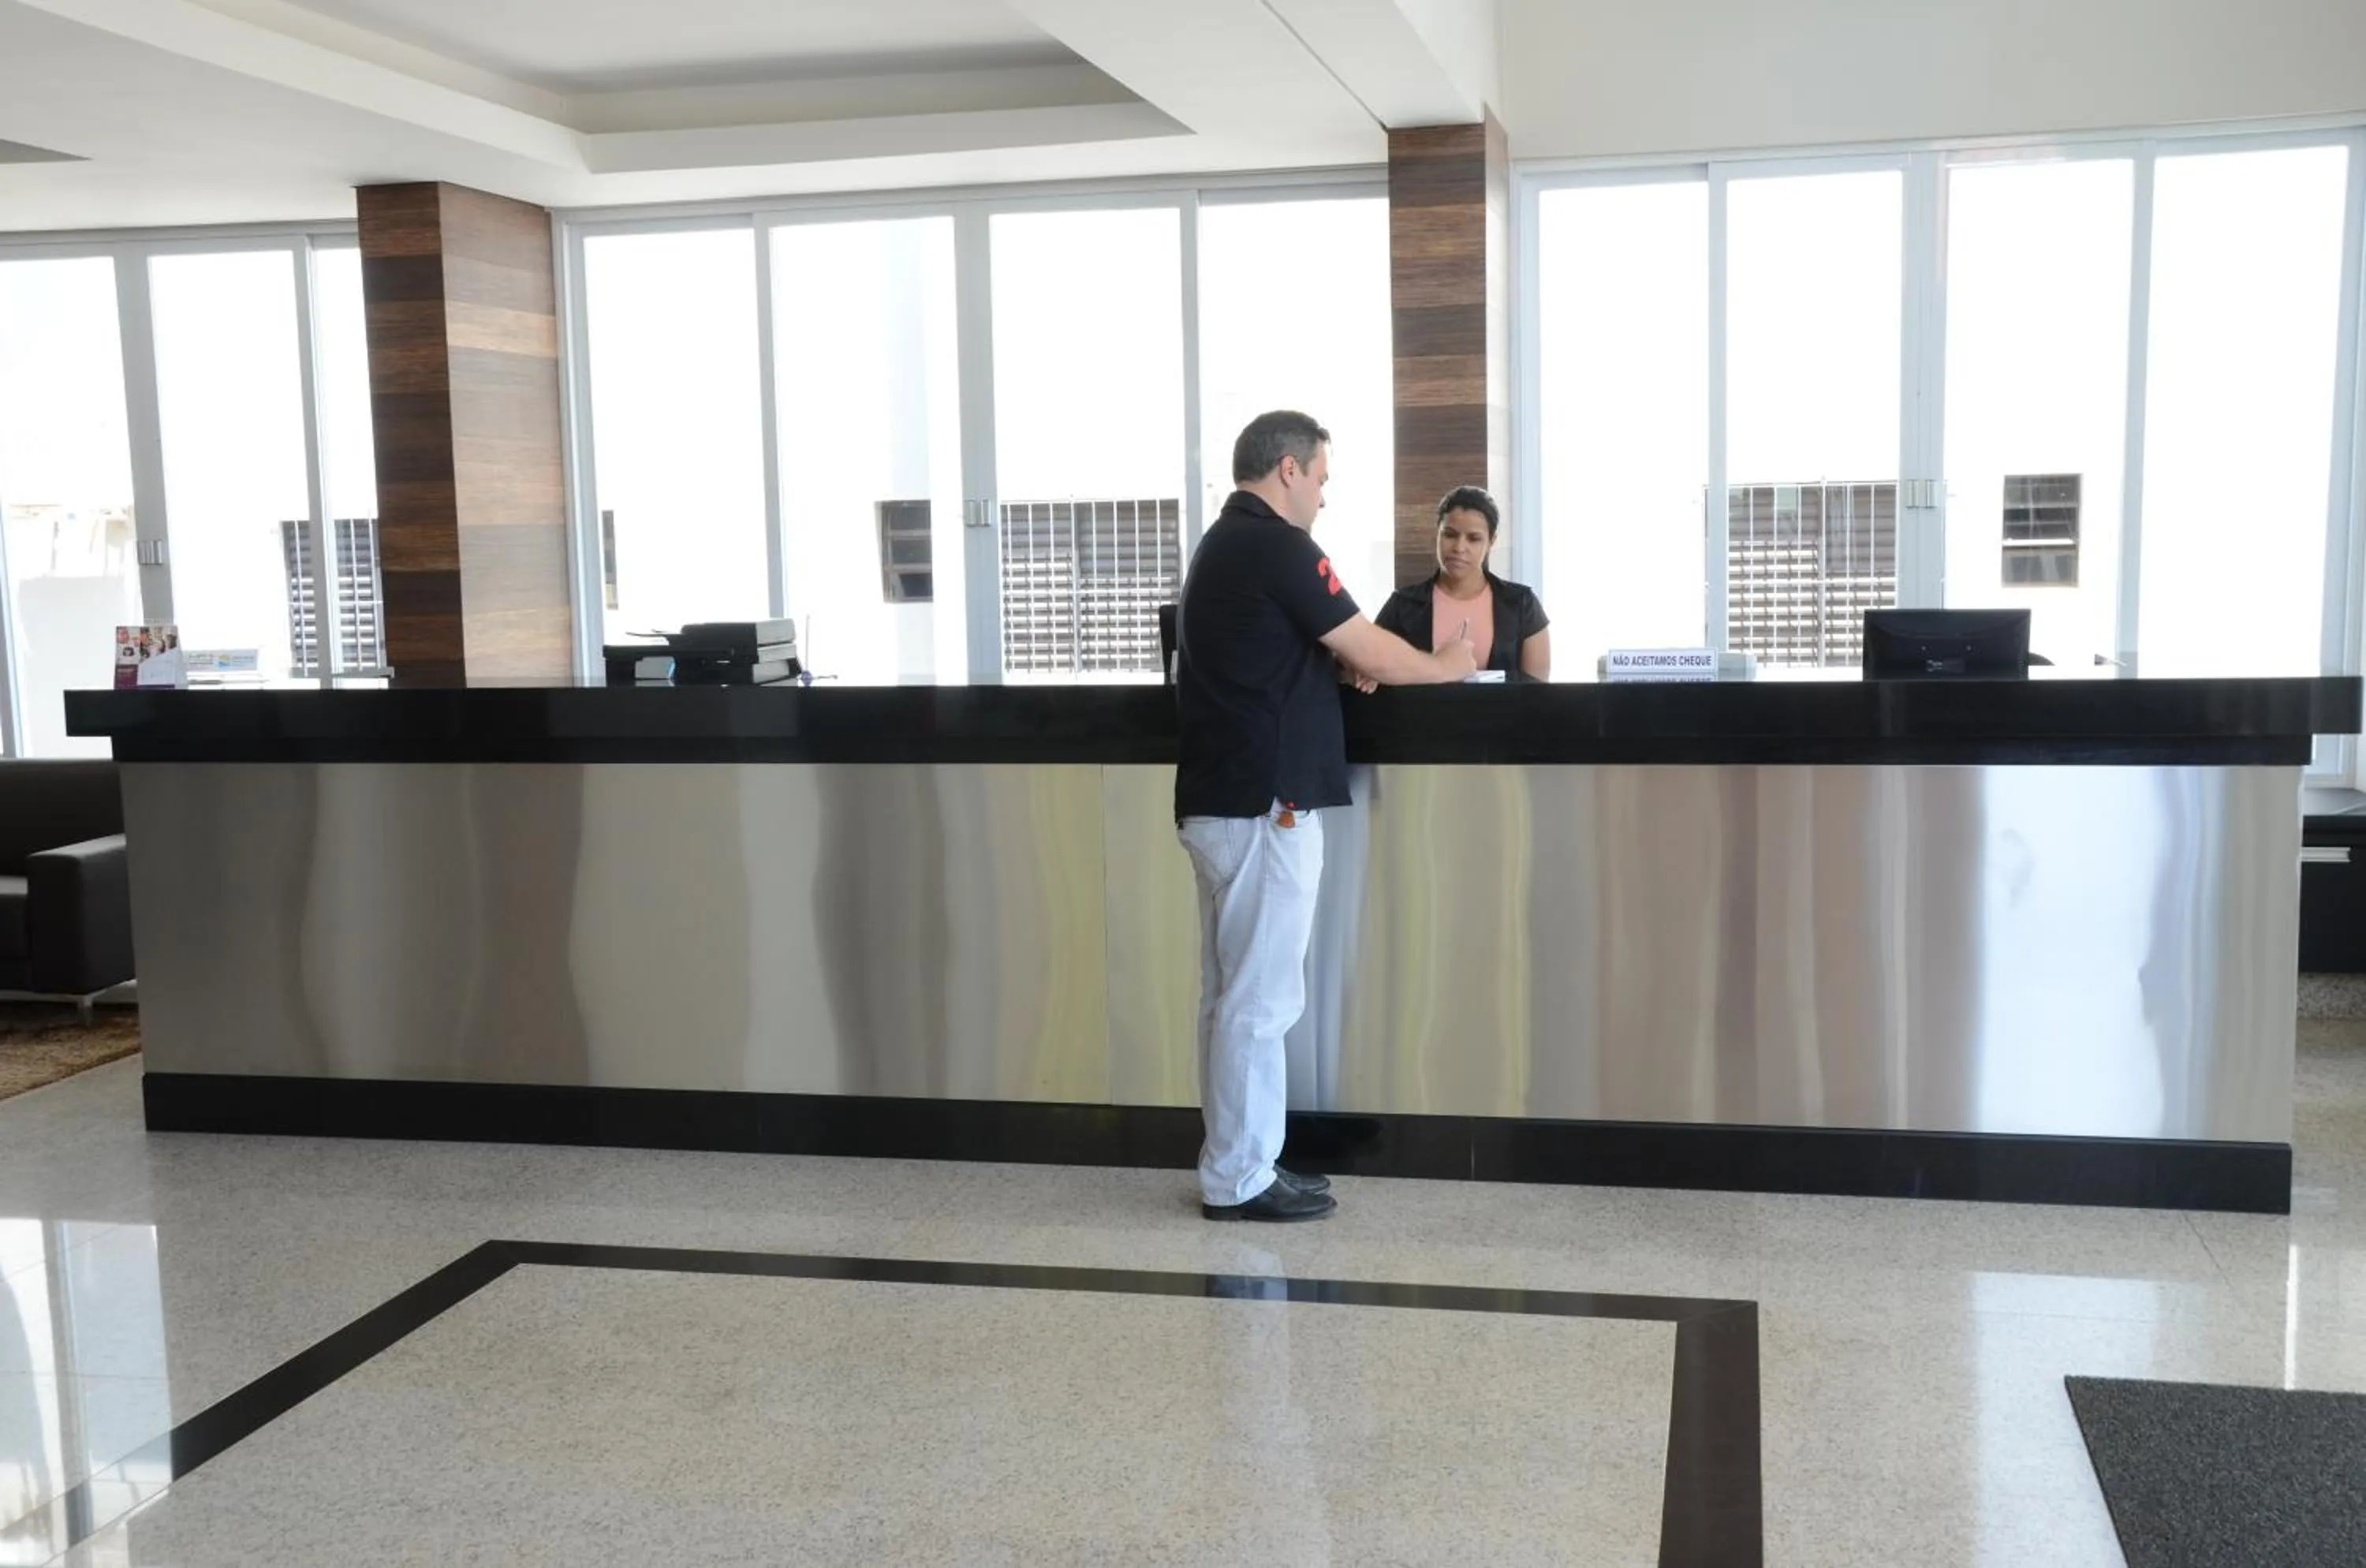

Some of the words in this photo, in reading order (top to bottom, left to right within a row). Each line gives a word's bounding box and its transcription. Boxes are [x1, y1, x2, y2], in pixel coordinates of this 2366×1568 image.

[1613, 653, 1630, 666] NÃO
[1632, 655, 1677, 666] ACEITAMOS
[1679, 655, 1711, 666] CHEQUE
